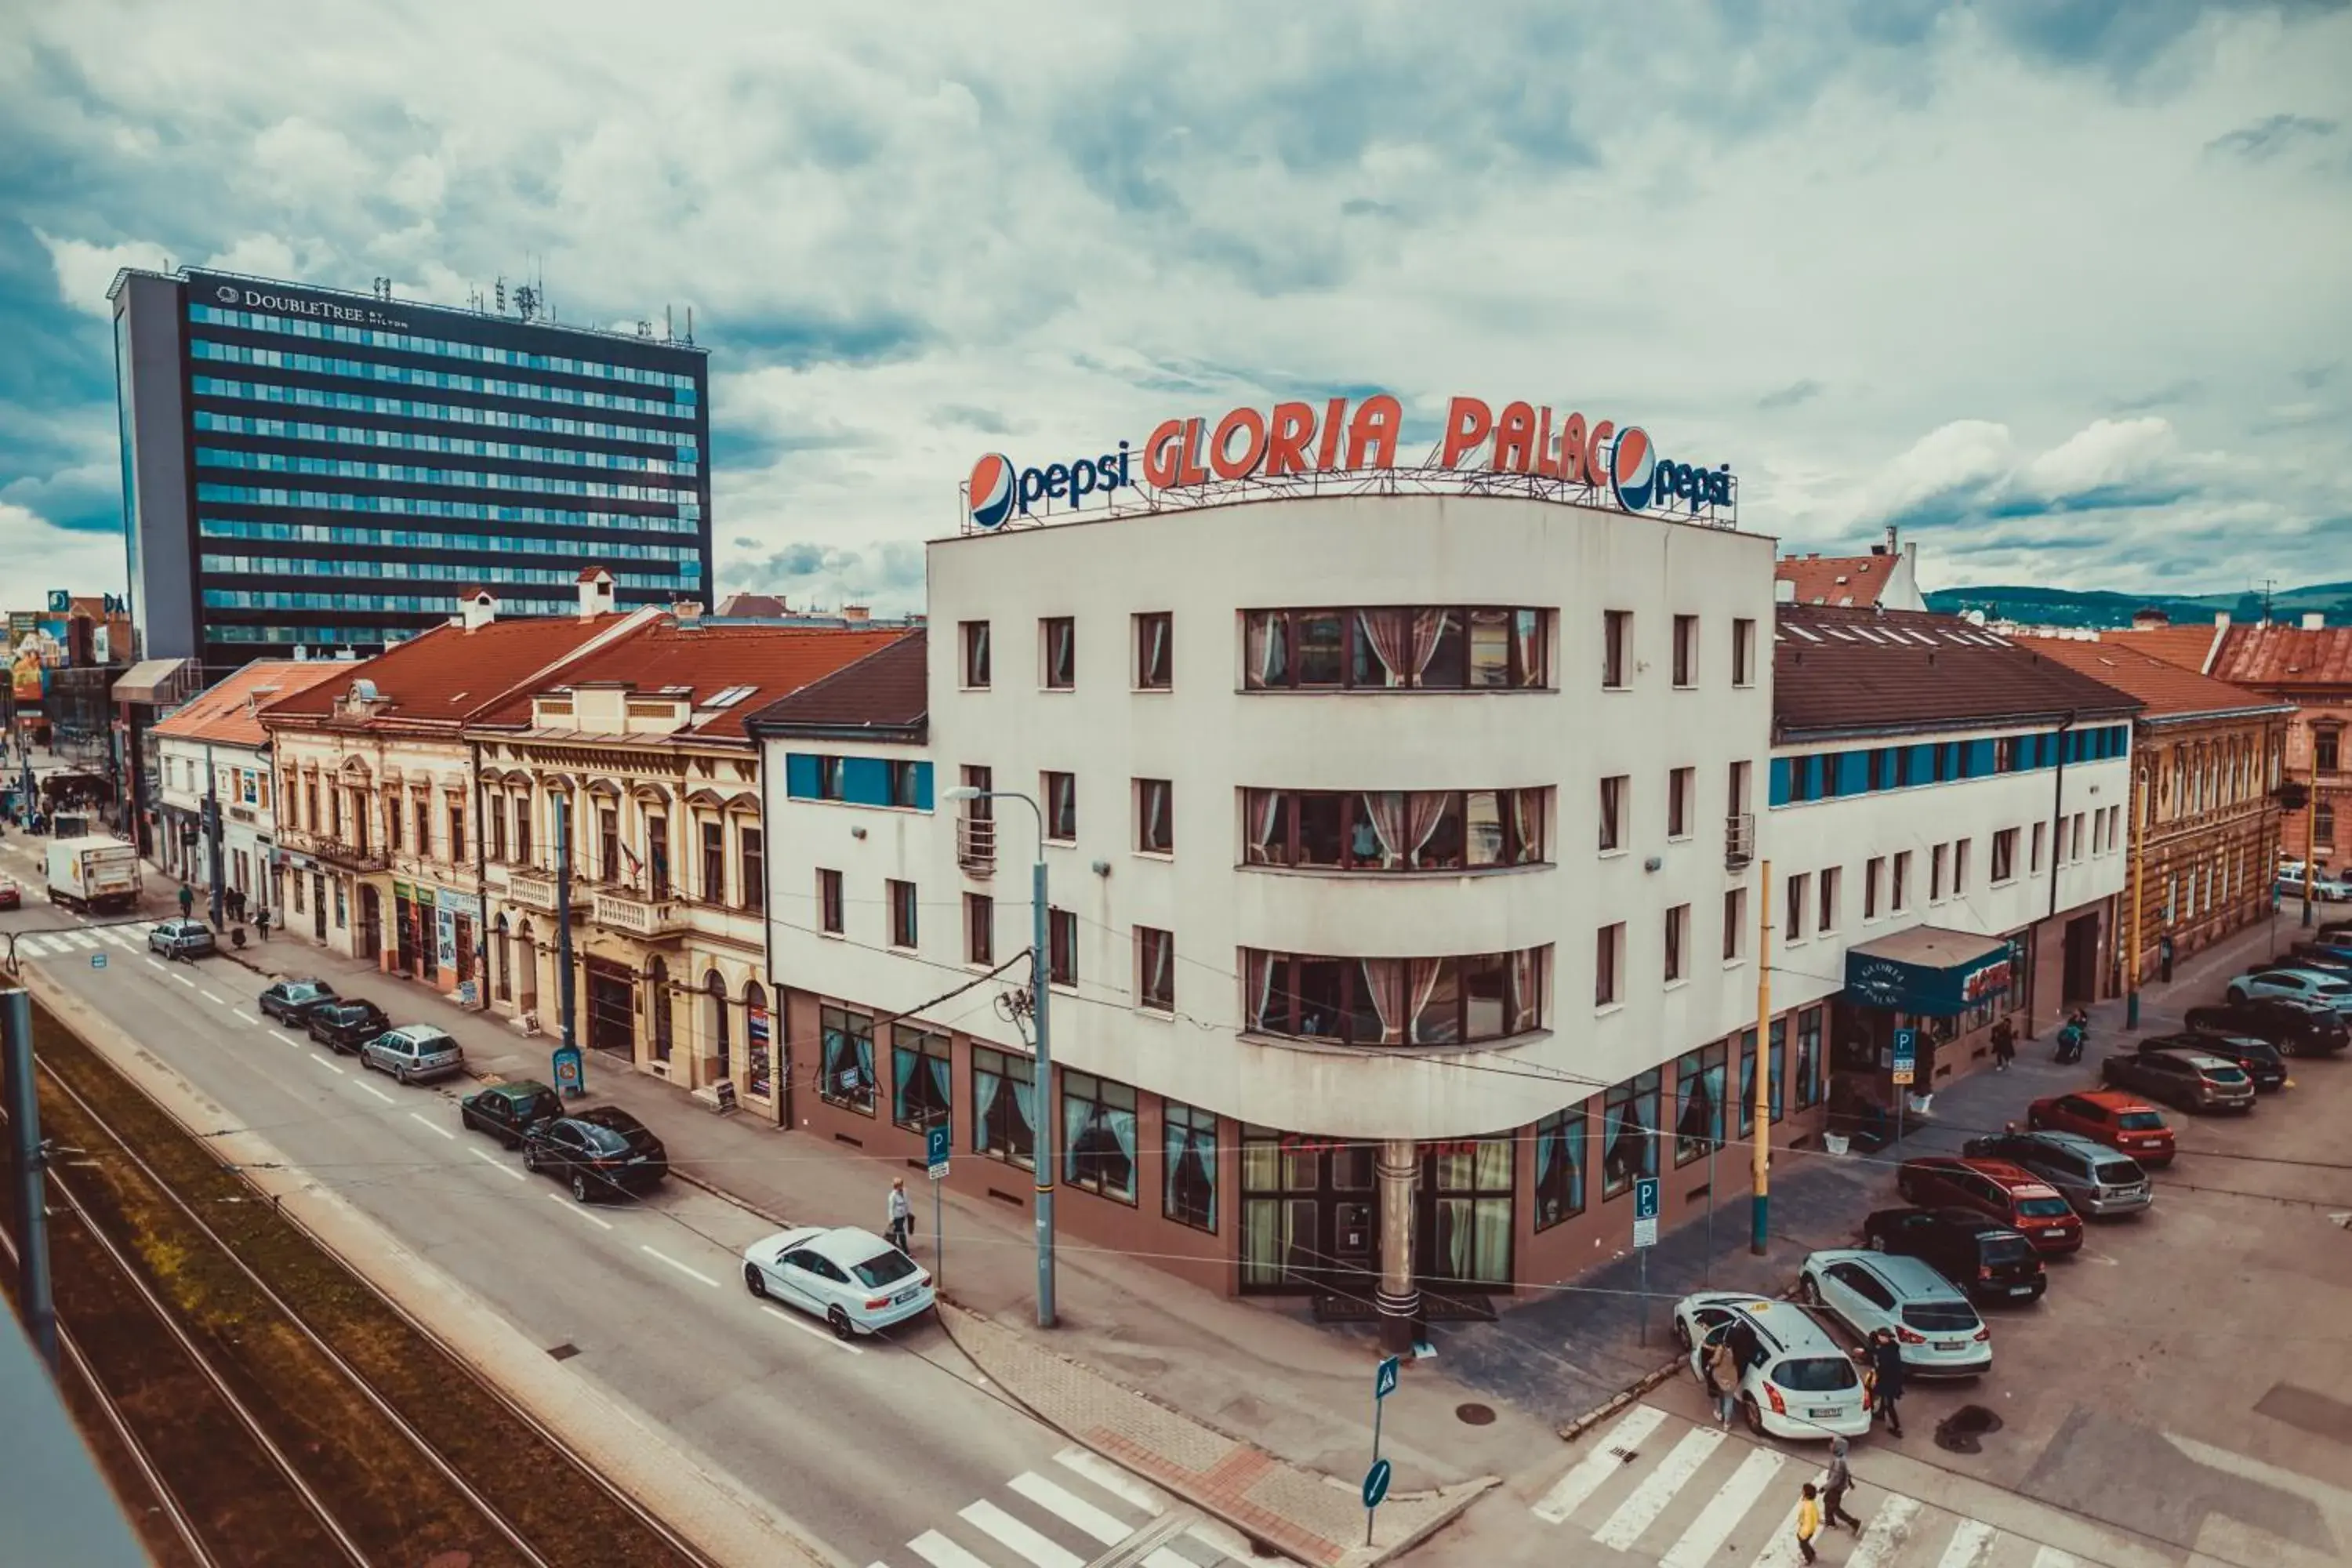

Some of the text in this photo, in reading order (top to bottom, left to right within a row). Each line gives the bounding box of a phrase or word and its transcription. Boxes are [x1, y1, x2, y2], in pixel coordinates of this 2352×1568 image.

[1143, 395, 1615, 488] GLORIA PALAC
[1019, 441, 1129, 514] pepsi
[1656, 458, 1732, 514] pepsi
[103, 592, 132, 613] DA
[1900, 1033, 1909, 1050] P
[934, 1133, 943, 1152] P
[1642, 1185, 1652, 1204] P
